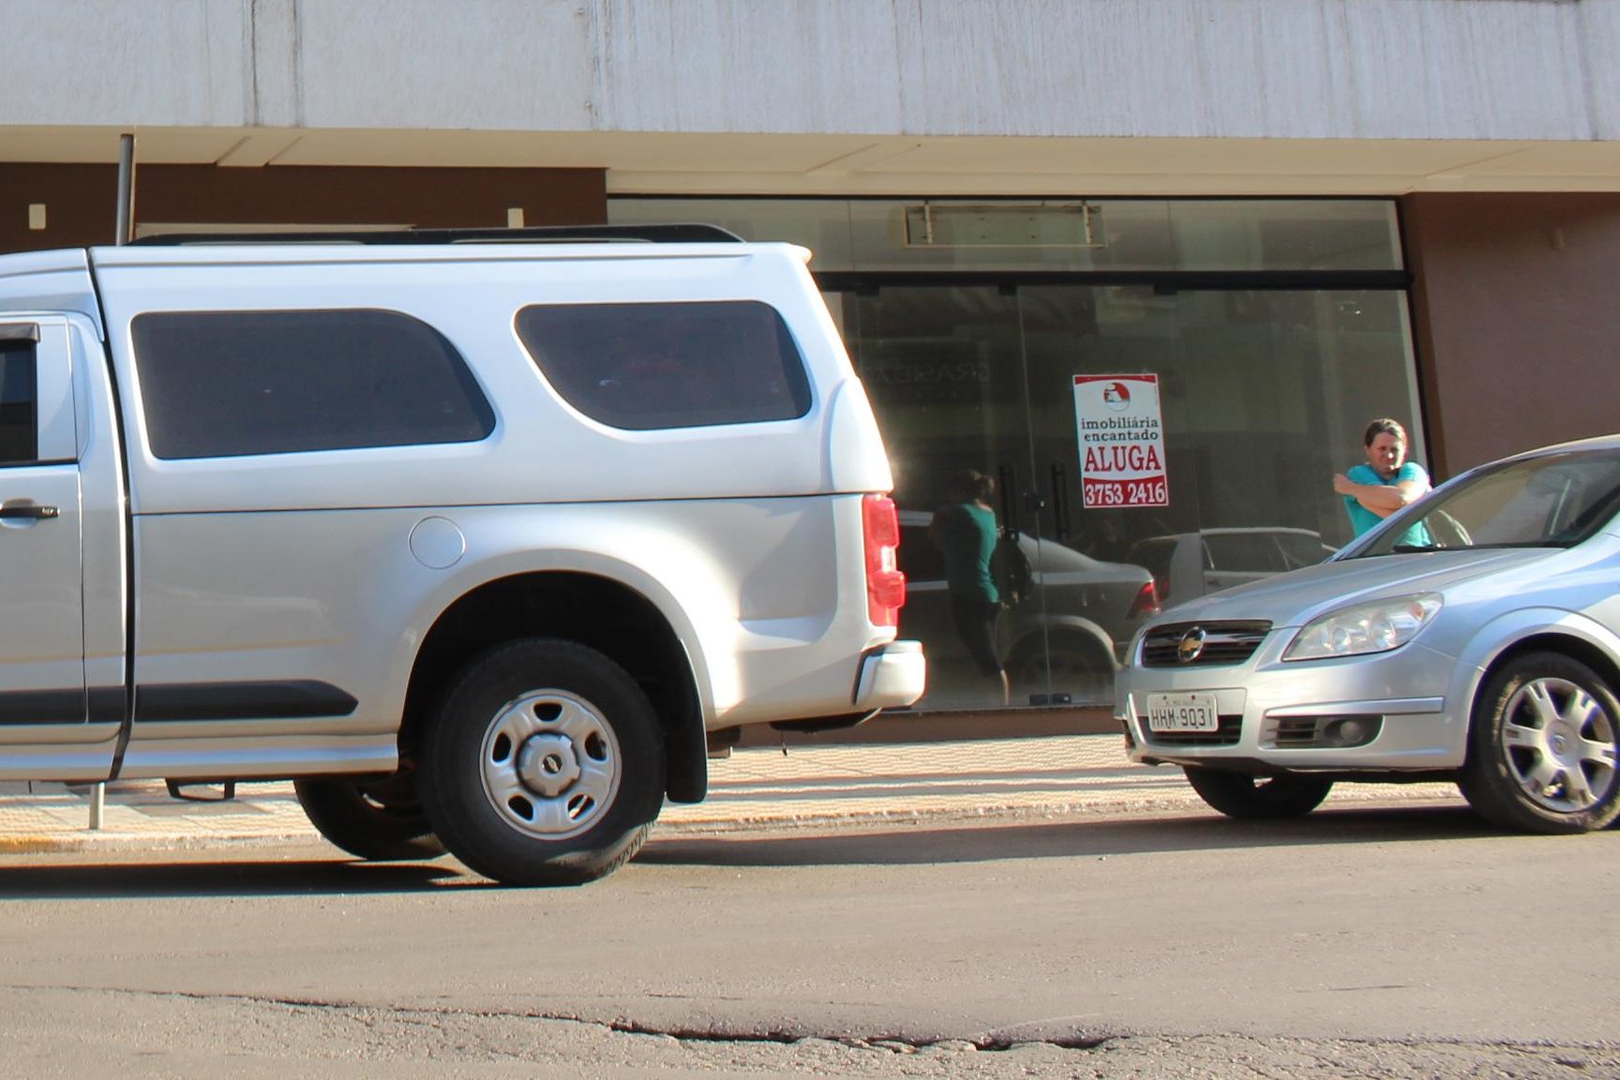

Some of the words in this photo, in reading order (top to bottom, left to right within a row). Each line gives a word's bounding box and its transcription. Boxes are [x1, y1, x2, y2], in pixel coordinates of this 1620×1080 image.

[1081, 417, 1158, 430] imobiliária
[1084, 429, 1158, 442] encantado
[1084, 445, 1161, 472] ALUGA
[1086, 483, 1123, 505] 3753
[1128, 482, 1165, 504] 2416
